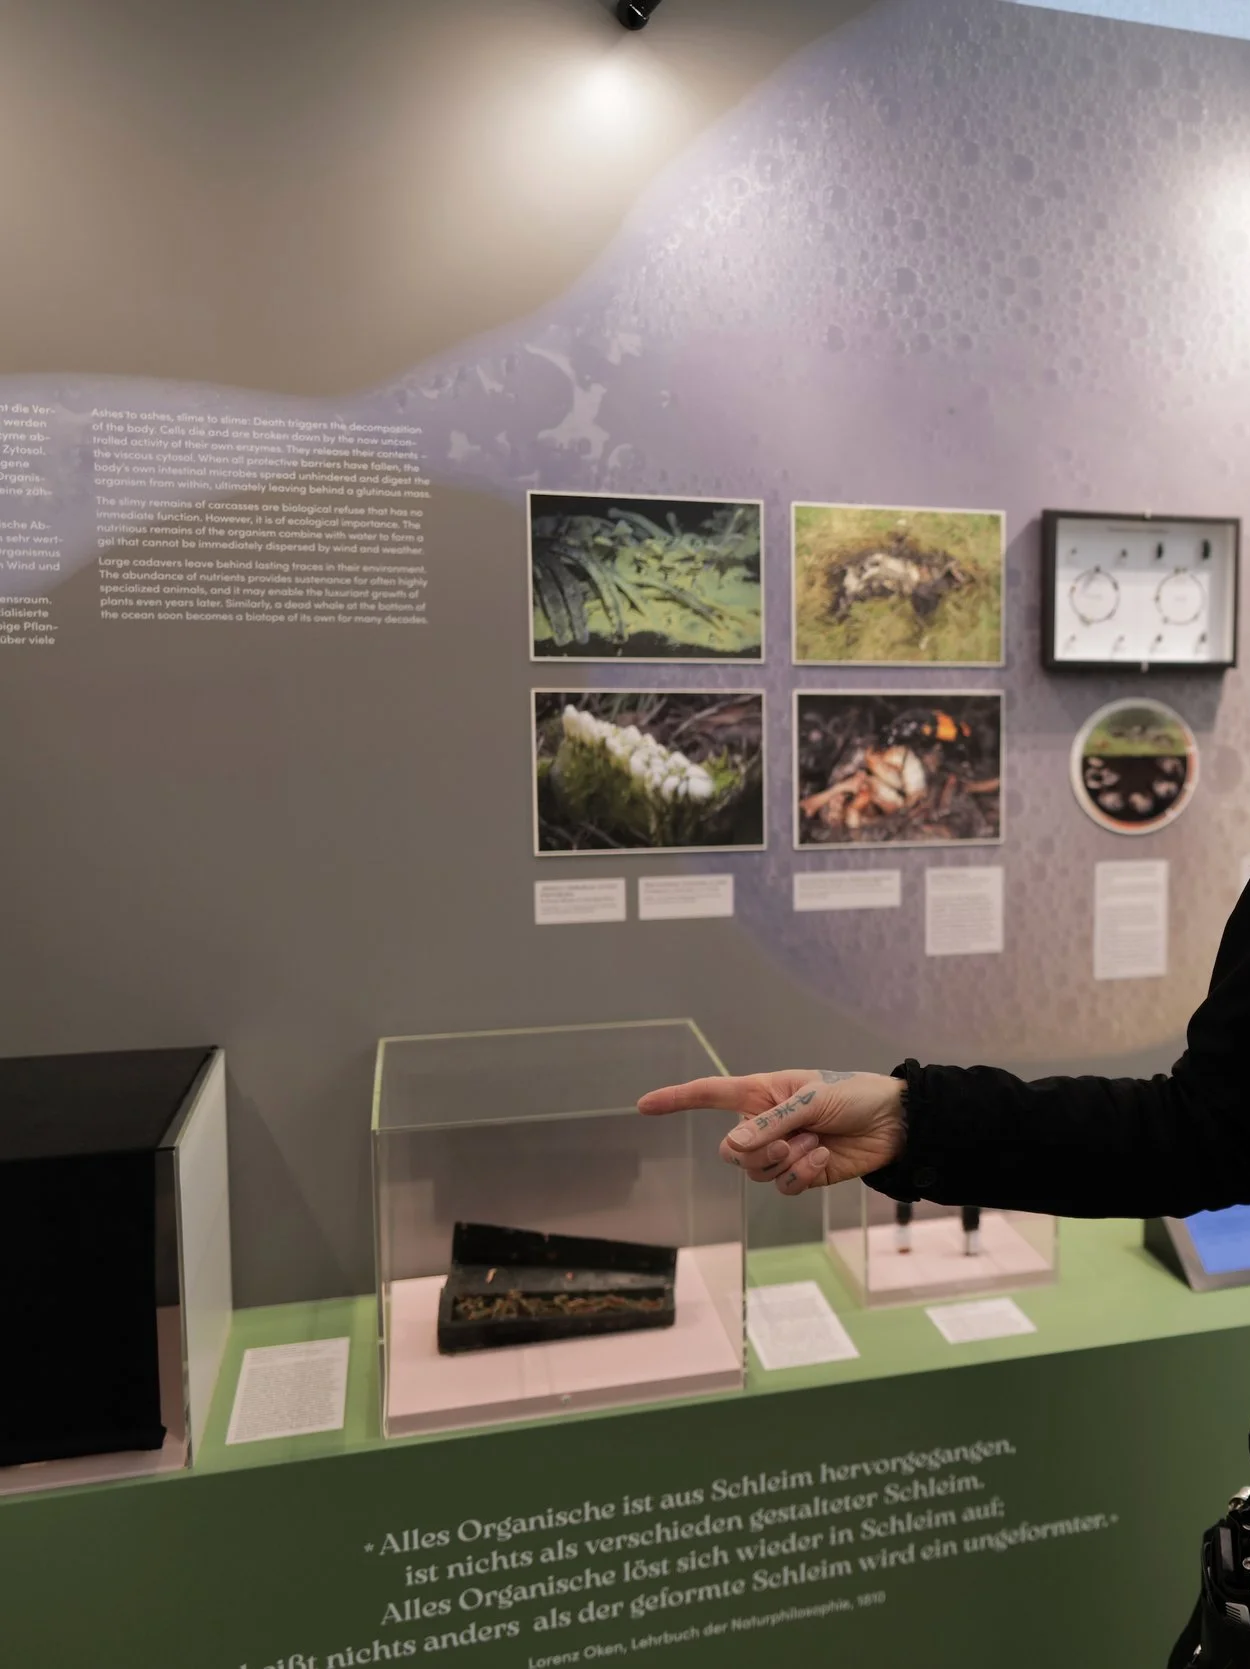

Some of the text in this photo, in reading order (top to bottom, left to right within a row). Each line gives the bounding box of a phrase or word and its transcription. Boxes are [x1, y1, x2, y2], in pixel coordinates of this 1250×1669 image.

[12, 403, 29, 413] die
[32, 404, 56, 414] Ver-
[3, 419, 47, 428] werden
[91, 407, 123, 417] Ashes
[125, 408, 137, 418] to
[139, 409, 175, 422] ashes,
[176, 411, 204, 422] slime
[207, 413, 217, 423] to
[253, 415, 285, 426] Death
[287, 417, 327, 431] triggers
[329, 420, 347, 430] the
[348, 421, 422, 436] decomposition
[30, 433, 51, 441] ab-
[92, 420, 103, 430] of
[105, 421, 124, 431] the
[159, 424, 185, 434] Cells
[188, 425, 205, 435] die
[207, 426, 229, 436] and
[252, 429, 289, 440] broken
[291, 431, 320, 441] down
[322, 432, 335, 444] by
[337, 433, 354, 443] the
[356, 436, 378, 444] now
[380, 438, 417, 446] uncon-
[0, 460, 29, 469] gene
[94, 448, 111, 457] the
[113, 448, 152, 459] viscous
[198, 452, 229, 463] When
[231, 454, 244, 463] all
[246, 455, 298, 468] protective
[300, 457, 341, 468] barriers
[343, 459, 368, 469] have
[403, 462, 419, 472] the
[95, 474, 145, 488] organism
[149, 477, 174, 487] from
[177, 478, 213, 490] within,
[214, 479, 266, 493] ultimately
[268, 482, 306, 495] leaving
[308, 483, 344, 494] behind
[355, 485, 401, 499] glutinous
[97, 495, 115, 504] The
[119, 496, 145, 508] slimy
[148, 497, 192, 507] remains
[194, 498, 206, 508] of
[207, 501, 259, 510] carcasses
[261, 503, 279, 511] are
[281, 502, 332, 515] biological
[333, 504, 365, 514] refuse
[367, 505, 387, 515] that
[389, 506, 408, 516] has
[30, 520, 52, 530] Ab-
[97, 508, 420, 530] immediate function. However, it is of ecological importance. The
[6, 533, 64, 544] sehr wert-
[98, 535, 114, 547] gel
[116, 535, 139, 545] that
[141, 536, 178, 547] cannot
[181, 537, 196, 547] be
[197, 538, 262, 552] immediately
[265, 540, 315, 553] dispersed
[317, 542, 330, 554] by
[332, 542, 357, 552] wind
[359, 543, 379, 553] and
[6, 560, 60, 571] Wind und
[99, 555, 130, 568] Large
[132, 556, 182, 567] cadavers
[184, 557, 213, 567] leave
[215, 558, 252, 568] behind
[254, 559, 289, 572] lasting
[291, 560, 323, 570] traces
[325, 561, 335, 570] in
[337, 561, 359, 571] their
[100, 569, 427, 588] The abundance of nutrients provides sustenance for often highly
[23, 621, 59, 631] Pflan-
[0, 635, 55, 644] über viele
[458, 1501, 615, 1542] Organische
[623, 1496, 652, 1516] ist
[660, 1489, 704, 1509] aus
[711, 1470, 813, 1501] Schleim
[406, 1475, 984, 1586] ist nichts als verschieden gestalteter Schleim.
[381, 1598, 451, 1625] Alles
[459, 1568, 616, 1610] Organische
[624, 1559, 669, 1582] löst
[677, 1546, 729, 1572] sich
[736, 1532, 820, 1562] wieder
[830, 1526, 854, 1546] in
[861, 1510, 956, 1539] Schleim
[327, 1640, 416, 1669] nichts
[424, 1621, 520, 1651] anders
[533, 1608, 571, 1631] als
[578, 1601, 624, 1623] der
[630, 1580, 745, 1618] geformte
[753, 1560, 852, 1591] Schleim
[859, 1543, 914, 1571] wird
[920, 1539, 957, 1560] ein
[529, 1652, 579, 1669] Lorenz
[584, 1644, 627, 1659] Oken,
[631, 1627, 699, 1650] Lehrbuch
[703, 1623, 728, 1636] der
